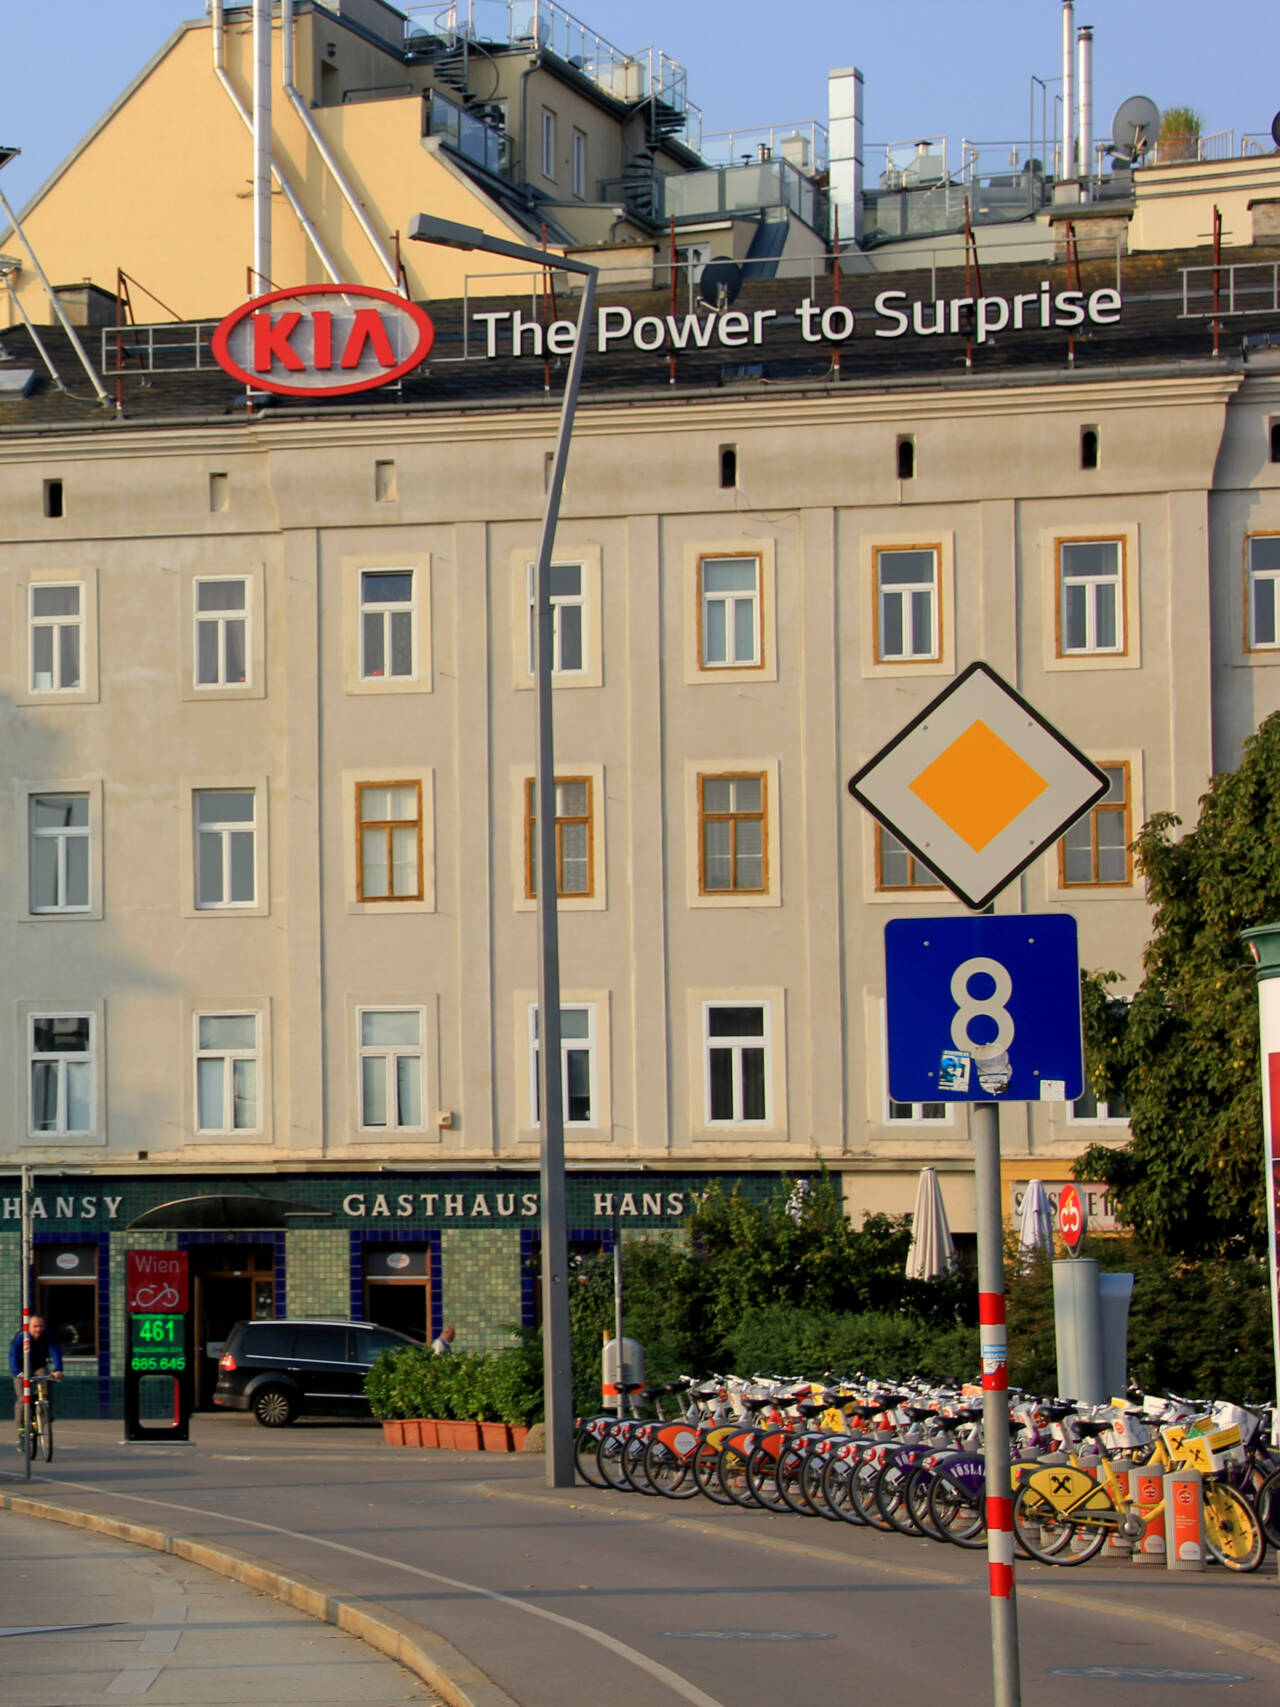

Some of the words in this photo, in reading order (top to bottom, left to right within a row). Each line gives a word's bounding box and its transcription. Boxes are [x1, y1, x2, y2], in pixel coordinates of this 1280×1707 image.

[472, 309, 578, 358] The
[598, 305, 777, 353] Power
[795, 297, 855, 342] to
[874, 280, 1122, 344] Surprise
[251, 308, 397, 372] KIA
[950, 956, 1015, 1061] 8
[2, 1196, 123, 1219] HANSY
[342, 1193, 538, 1217] GASTHAUS
[135, 1255, 180, 1273] Wien
[140, 1320, 174, 1342] 461
